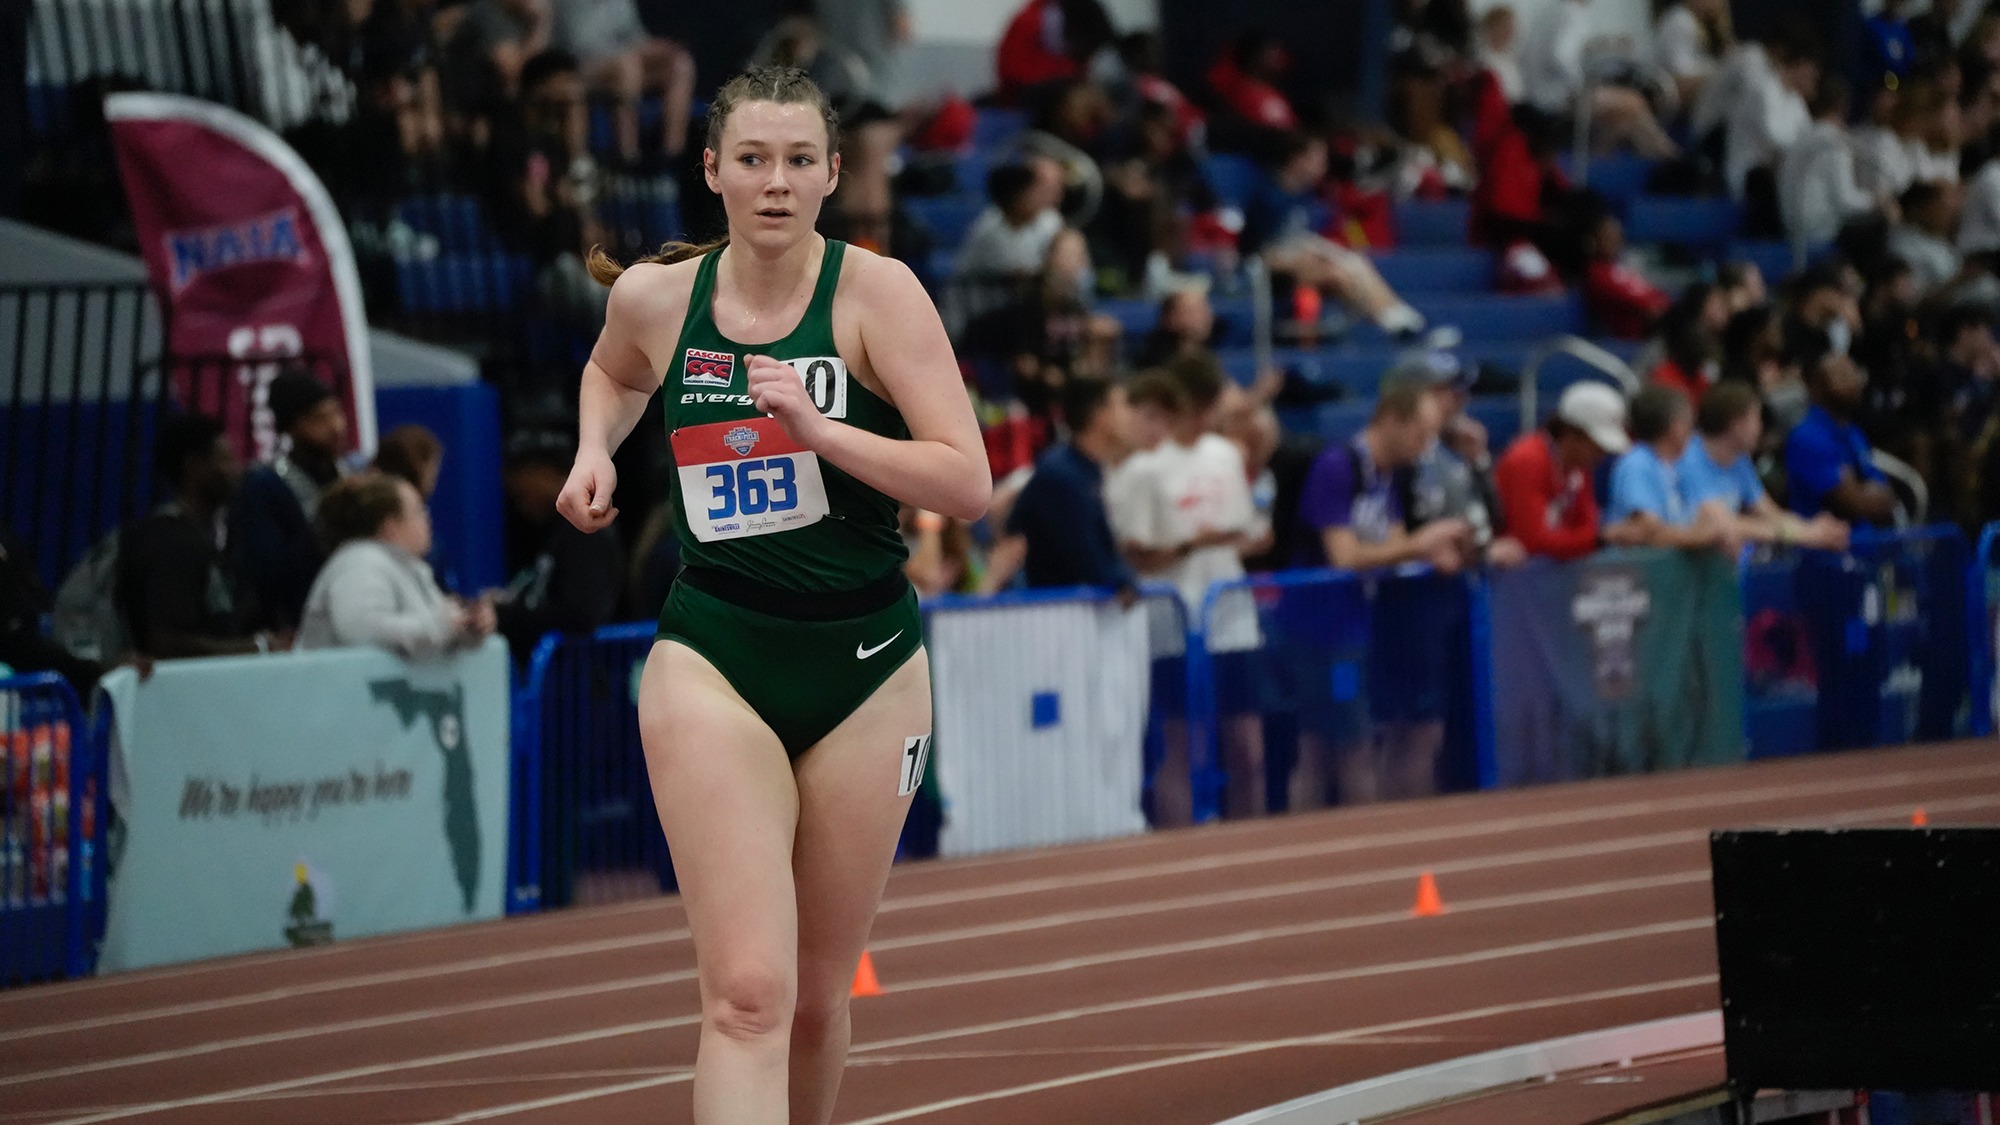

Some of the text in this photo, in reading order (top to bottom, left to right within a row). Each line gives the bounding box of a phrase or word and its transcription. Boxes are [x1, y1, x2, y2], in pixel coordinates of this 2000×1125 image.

[166, 210, 307, 291] NAIA
[687, 349, 733, 361] CASCADE
[687, 360, 731, 377] CCC
[705, 456, 799, 521] 363
[248, 772, 305, 828] happy
[374, 759, 413, 802] here
[907, 735, 931, 792] 10
